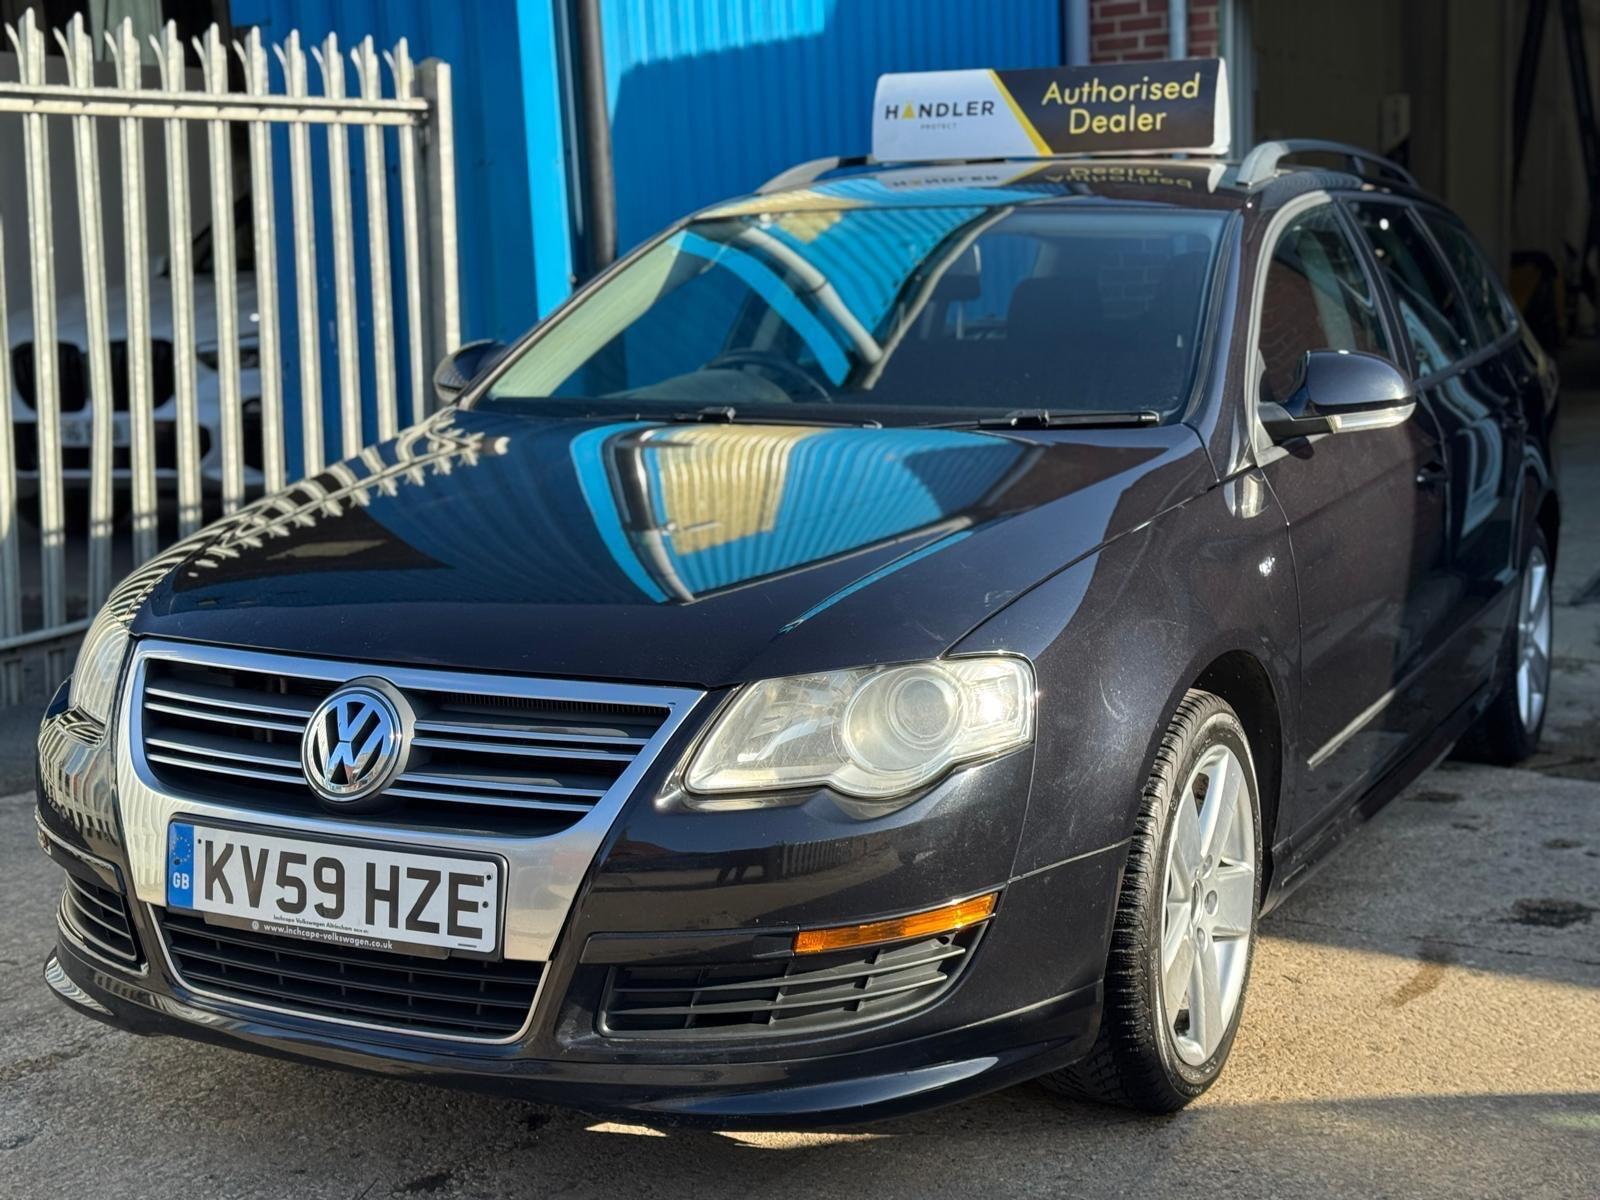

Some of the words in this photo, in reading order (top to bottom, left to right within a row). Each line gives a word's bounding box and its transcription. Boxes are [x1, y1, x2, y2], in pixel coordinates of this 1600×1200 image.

[1041, 71, 1200, 106] Authorised
[884, 100, 995, 120] HANDLER
[1069, 104, 1168, 135] Dealer
[172, 872, 190, 890] GB
[204, 839, 346, 920] KV59
[365, 861, 486, 940] HZE
